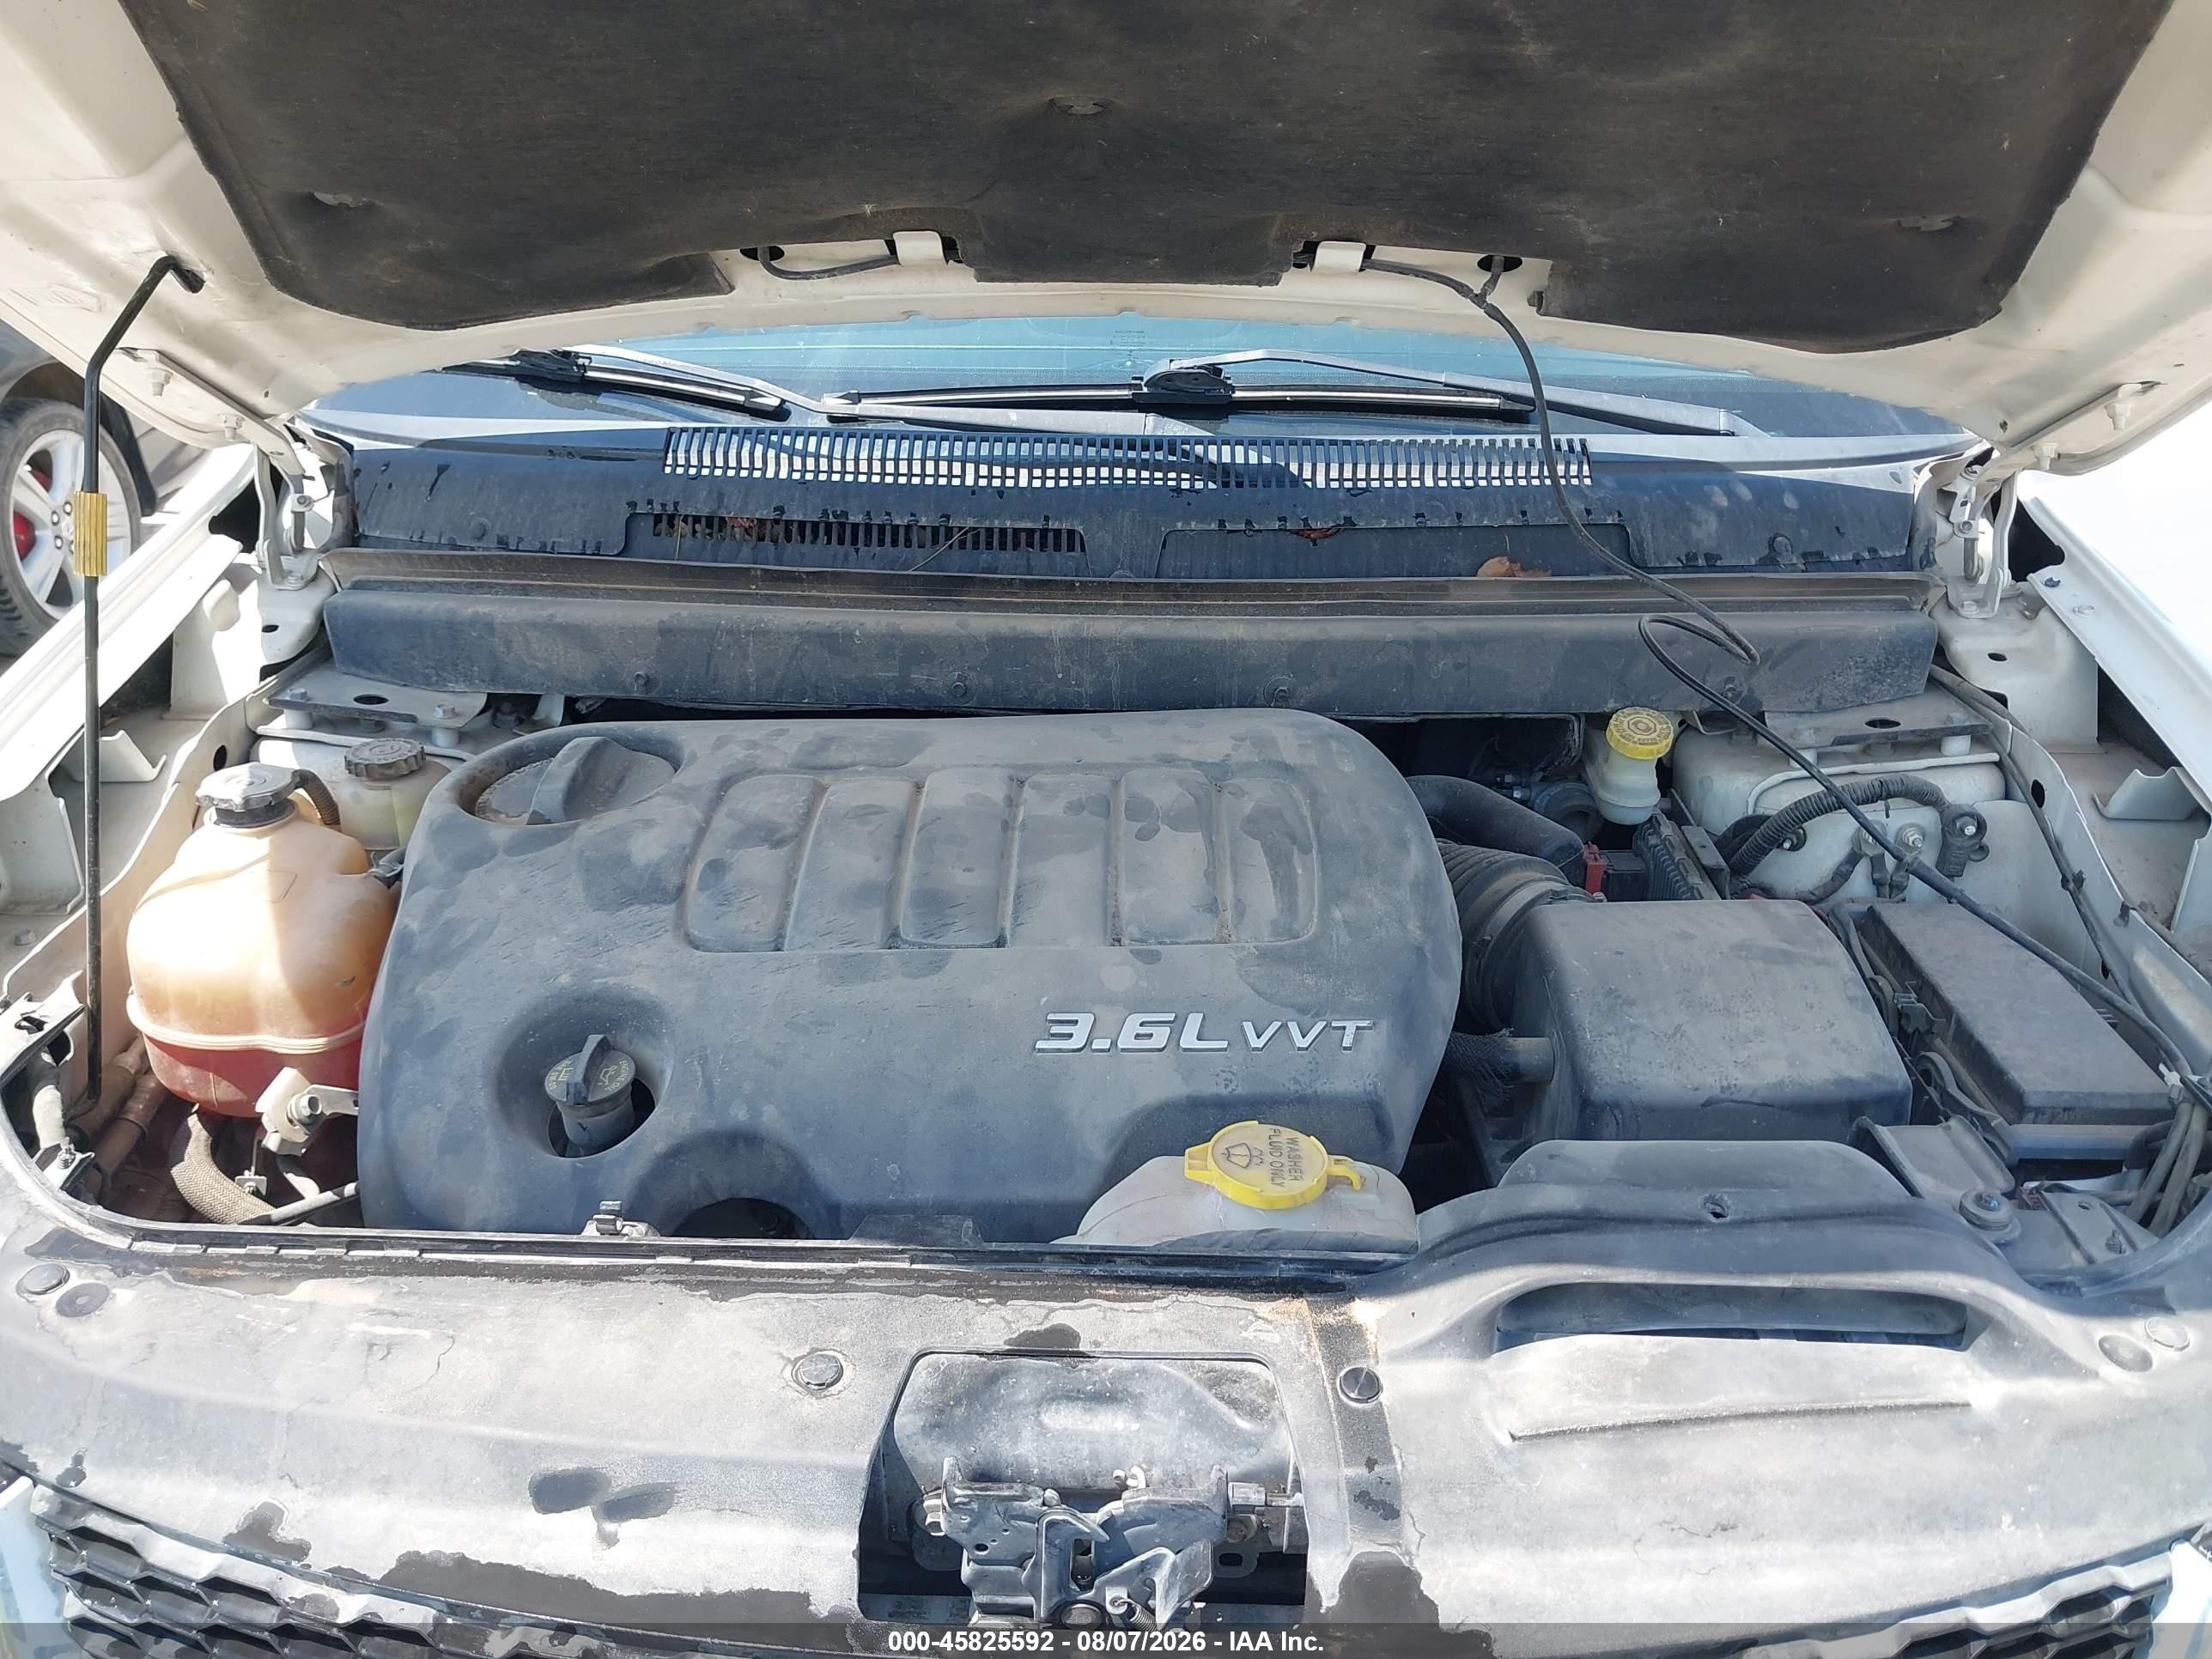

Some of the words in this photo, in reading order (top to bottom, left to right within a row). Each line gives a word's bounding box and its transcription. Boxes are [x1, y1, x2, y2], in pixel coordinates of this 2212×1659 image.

[1036, 1012, 1228, 1053] 3.6L
[1243, 1020, 1373, 1052] VVT
[617, 1059, 629, 1082] ENGINE
[605, 1082, 620, 1091] OIL
[1268, 1128, 1283, 1158] FLUID
[1286, 1137, 1304, 1181] WASHER
[1270, 1160, 1285, 1188] ONLY
